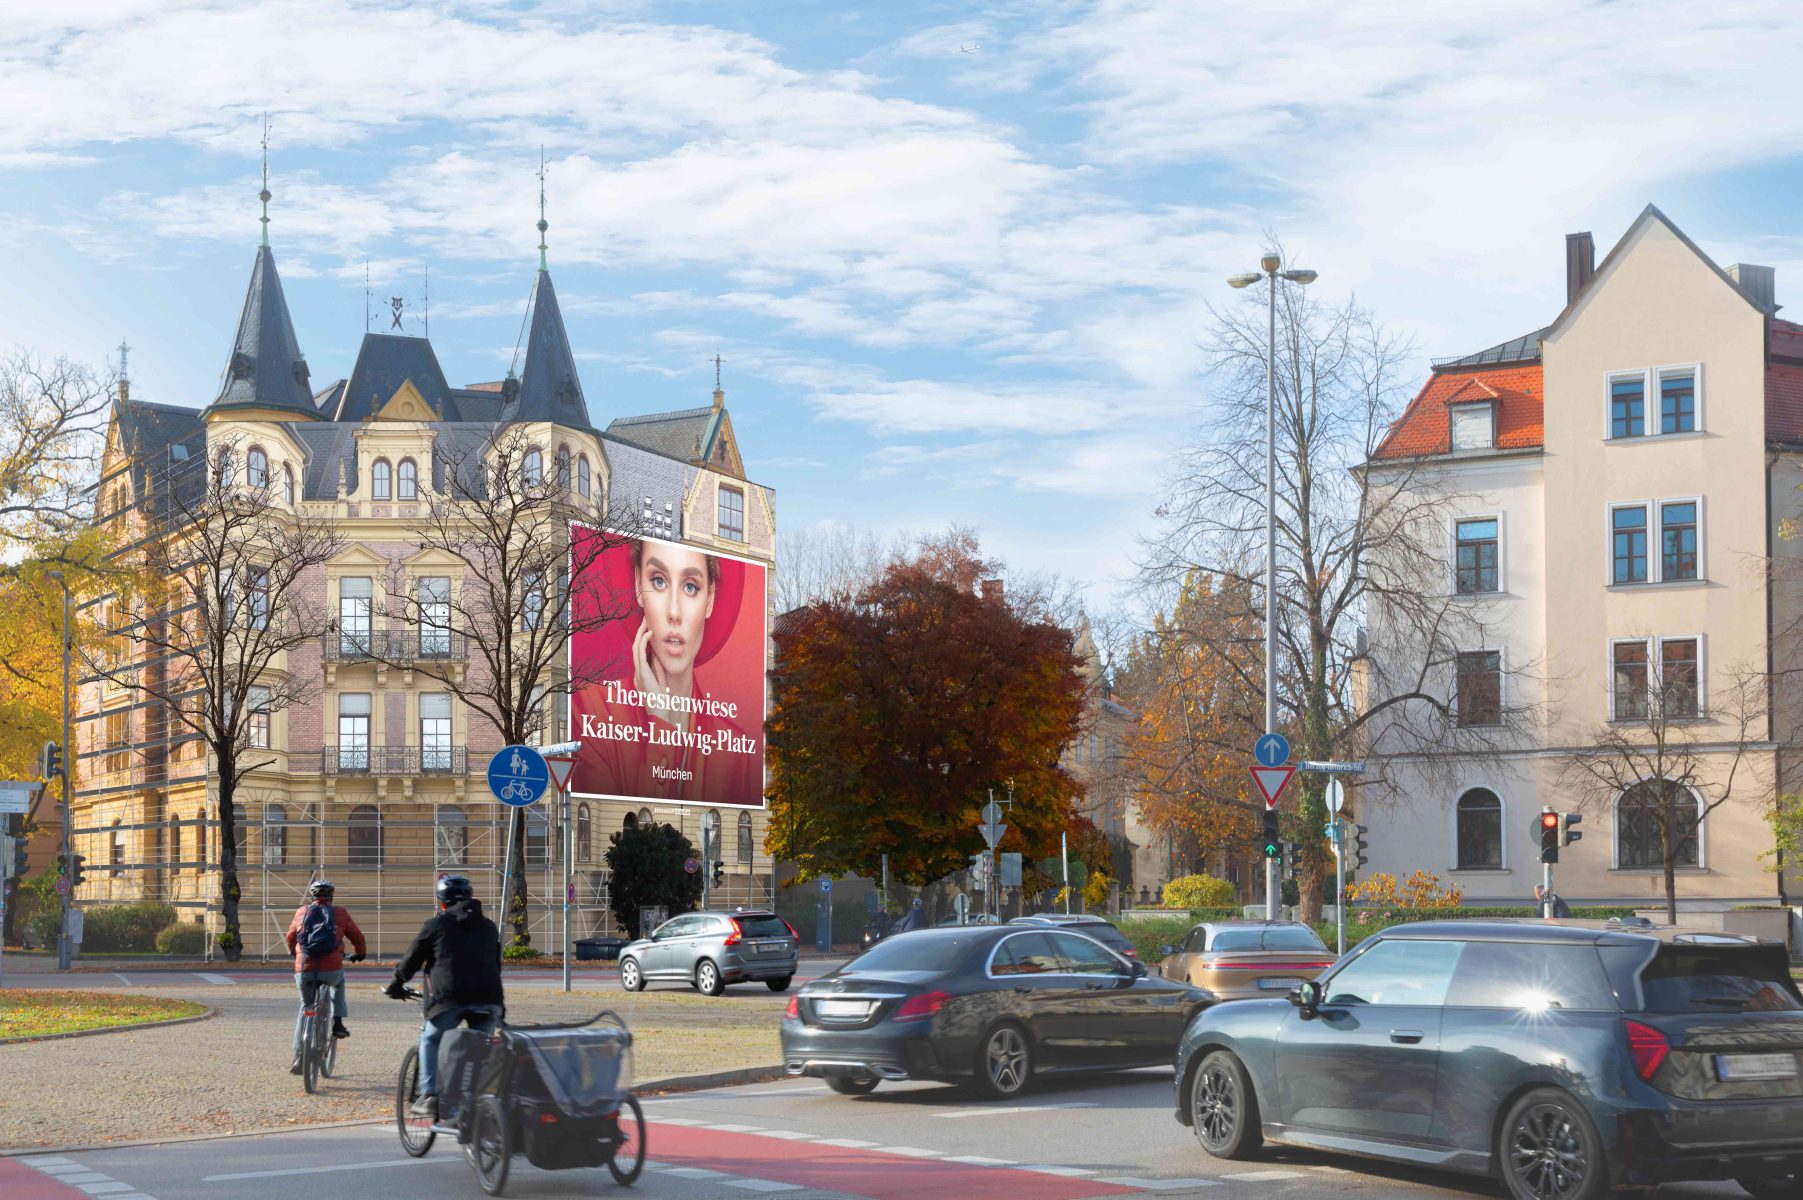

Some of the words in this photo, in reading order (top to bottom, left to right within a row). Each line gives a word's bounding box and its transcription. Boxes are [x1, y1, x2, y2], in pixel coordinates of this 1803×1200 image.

[603, 680, 737, 719] Theresienwiese
[581, 714, 756, 755] Kaiser-Ludwig-Platz
[652, 765, 693, 781] München
